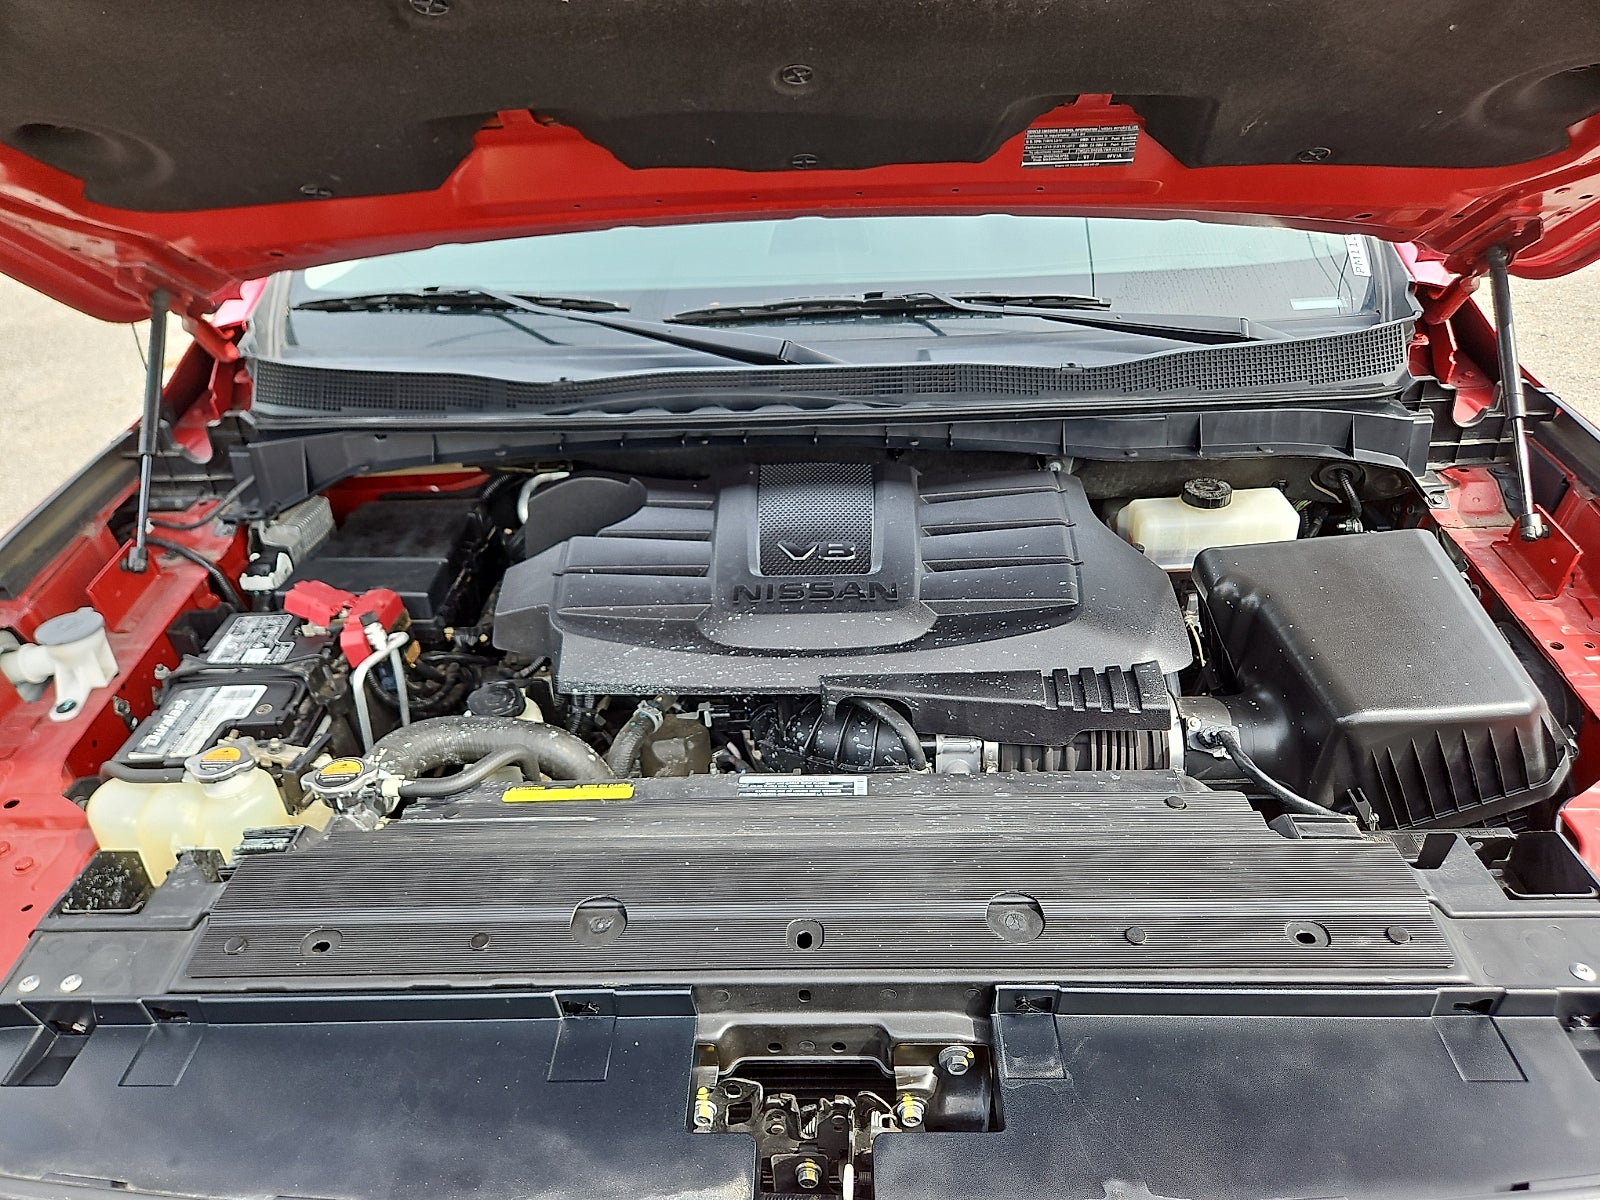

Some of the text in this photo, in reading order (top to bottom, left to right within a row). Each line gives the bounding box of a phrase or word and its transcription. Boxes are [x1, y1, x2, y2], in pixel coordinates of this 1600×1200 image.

[776, 540, 857, 561] V8
[732, 581, 899, 604] NISSAN
[140, 699, 191, 748] Duralast
